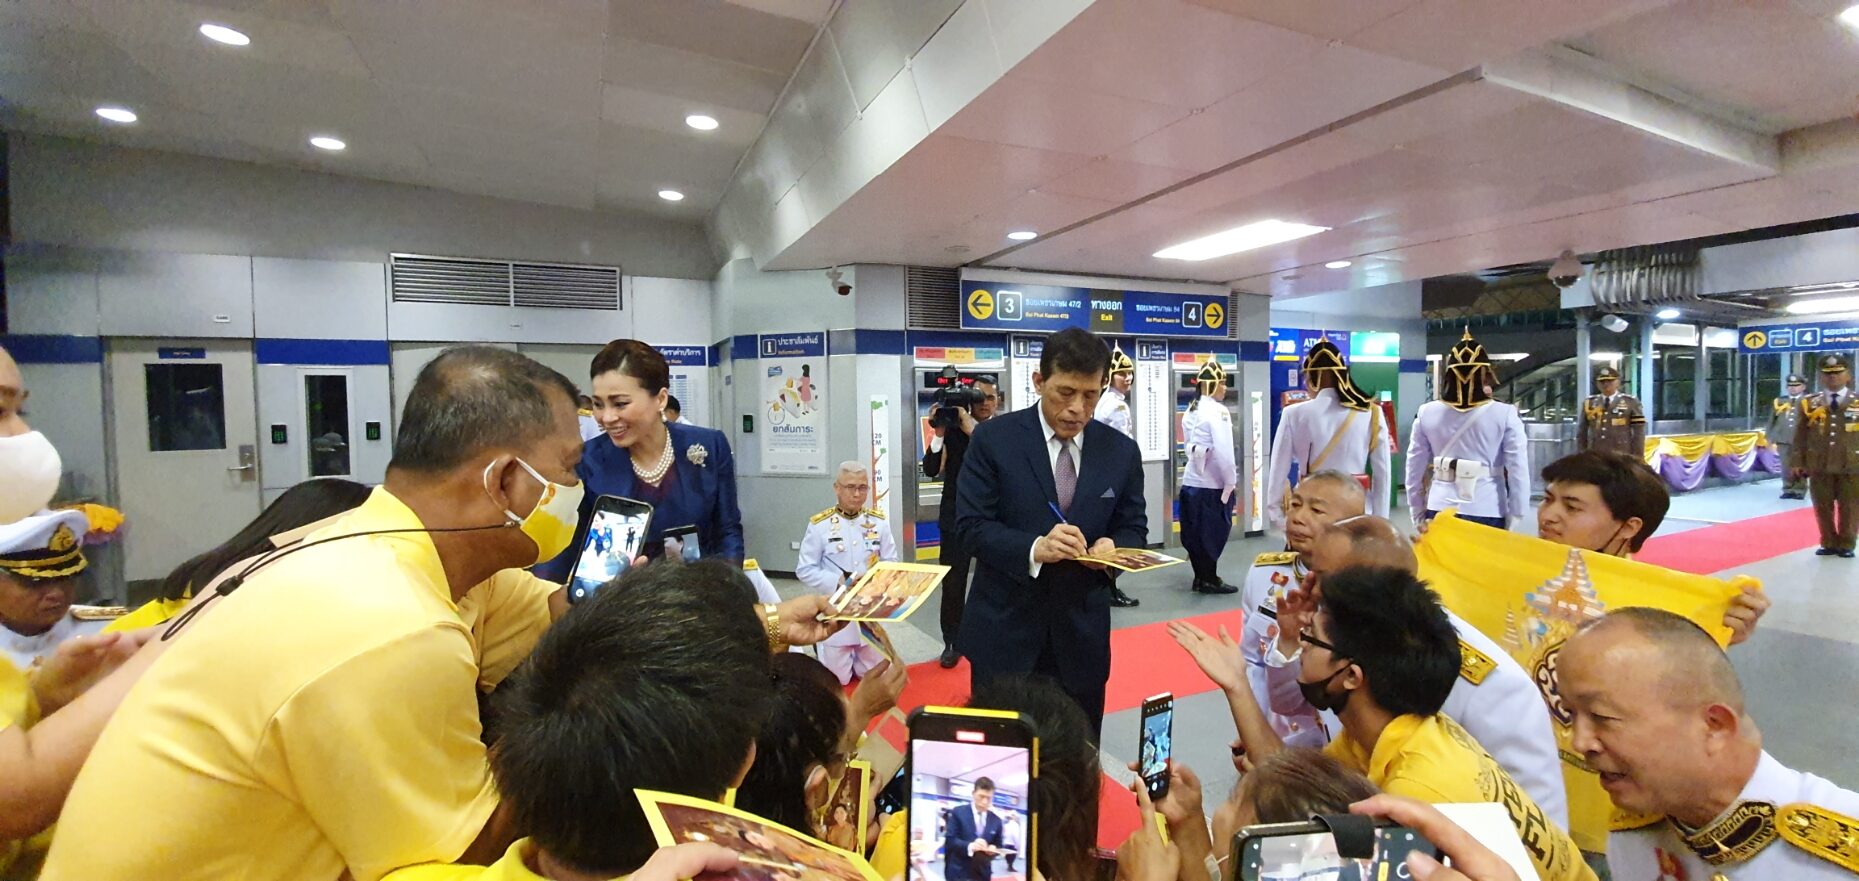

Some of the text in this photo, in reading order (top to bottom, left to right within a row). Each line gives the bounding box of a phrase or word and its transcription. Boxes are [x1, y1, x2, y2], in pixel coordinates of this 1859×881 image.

[1005, 297, 1014, 313] 3
[1091, 300, 1123, 310] ทางออก
[1101, 313, 1113, 321] Exit
[1188, 307, 1196, 321] 4
[1802, 331, 1812, 342] 4
